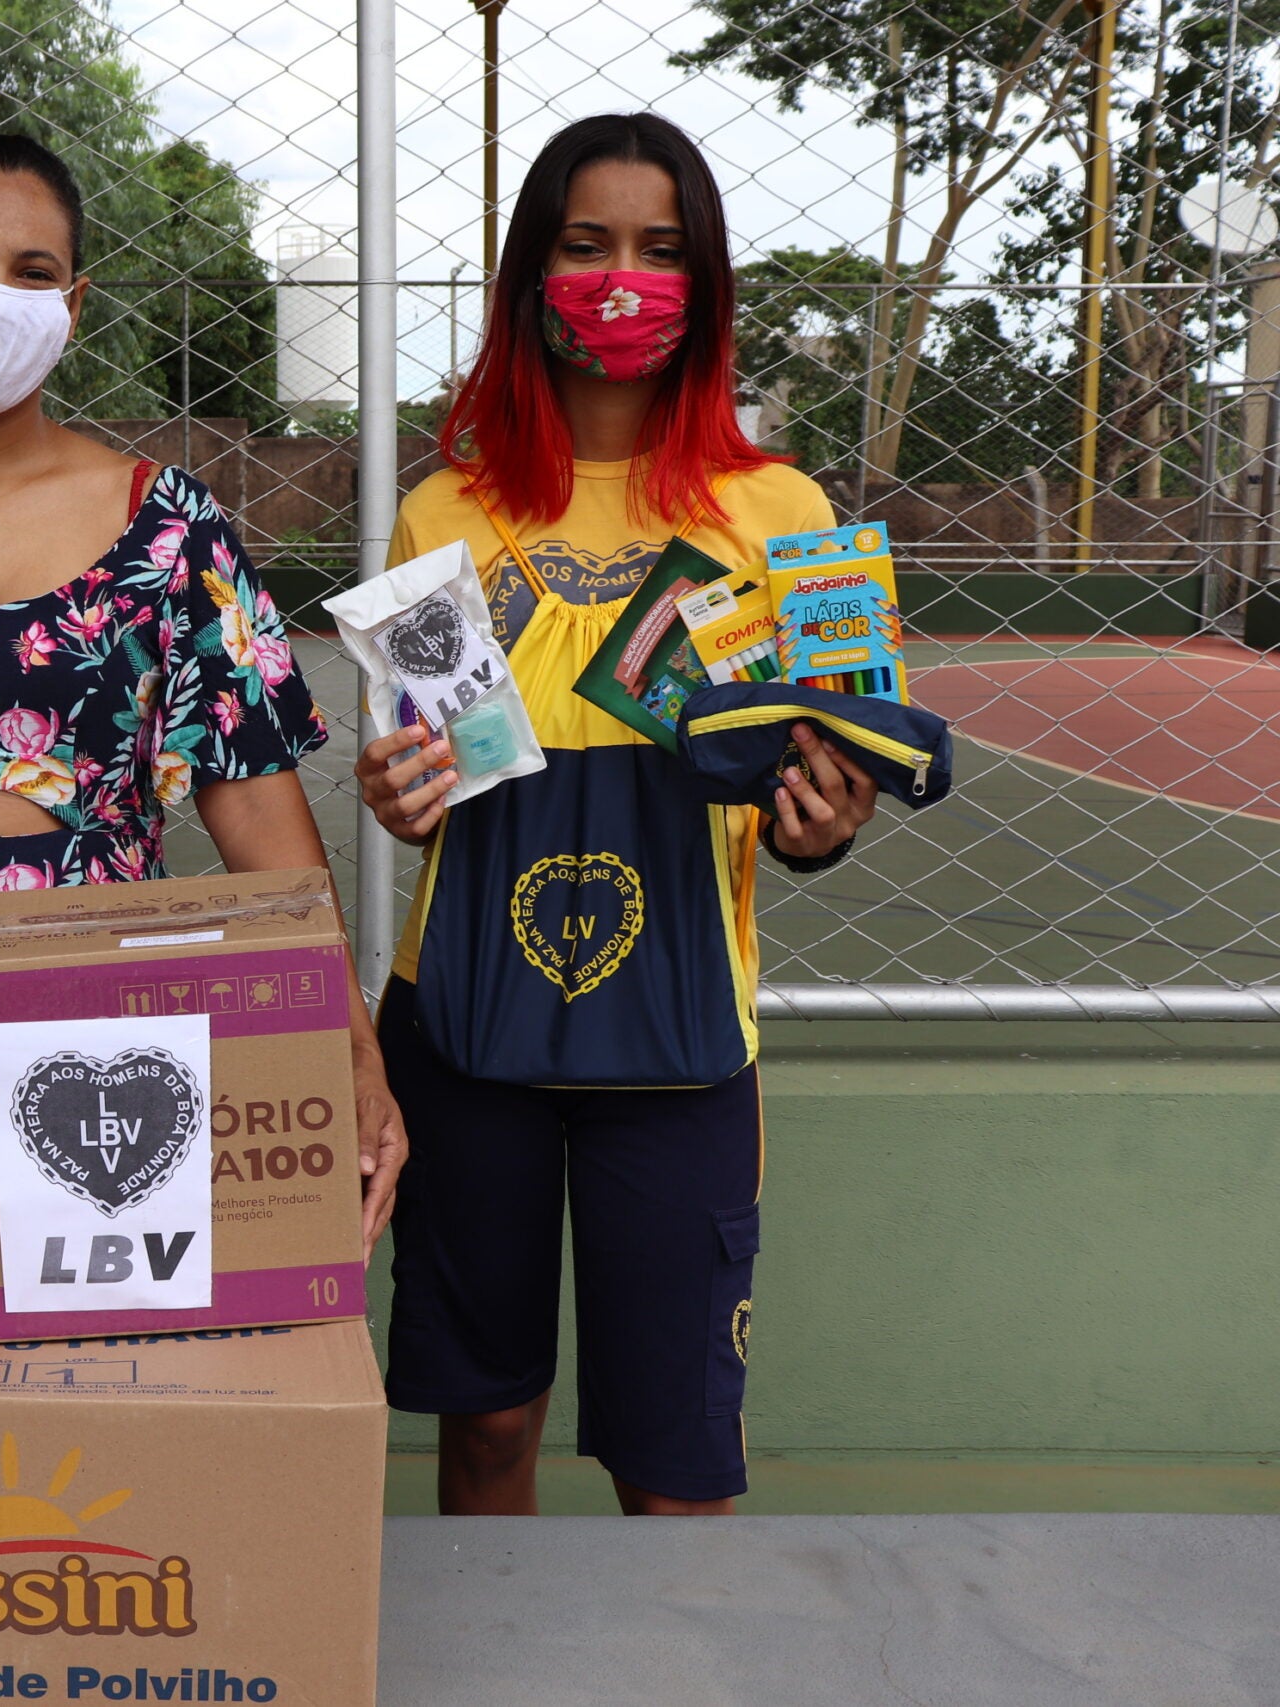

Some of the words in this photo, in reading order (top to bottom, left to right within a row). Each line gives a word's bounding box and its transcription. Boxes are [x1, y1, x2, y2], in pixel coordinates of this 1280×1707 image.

[774, 540, 798, 551] LÁPIS
[780, 548, 803, 560] COR
[794, 573, 867, 594] Jandainha
[410, 606, 437, 631] HOMENS
[805, 600, 861, 622] LÁPIS
[819, 616, 872, 642] COR
[418, 630, 445, 658] LBV
[624, 640, 640, 664] EDIÇÃO
[436, 658, 494, 722] LBV
[548, 868, 578, 883] AOS
[614, 876, 632, 896] DE
[522, 878, 547, 926] TERRA
[619, 900, 636, 931] BOA
[529, 926, 546, 947] NA
[542, 944, 567, 968] PAZ
[572, 932, 626, 984] VONTADE
[300, 976, 312, 990] 5
[50, 1066, 85, 1083] AOS
[89, 1064, 162, 1087] HOMENS
[164, 1074, 186, 1096] DE
[26, 1082, 50, 1138] TERRA
[172, 1100, 190, 1136] BOA
[80, 1118, 142, 1147] LBV
[41, 1136, 62, 1160] NA
[60, 1156, 90, 1182] PAZ
[117, 1140, 180, 1196] VONTADE
[268, 1192, 322, 1206] Produtos
[227, 1208, 273, 1223] negócio
[39, 1230, 196, 1285] LBV
[308, 1276, 339, 1307] 10
[66, 1665, 278, 1702] Polvilho
